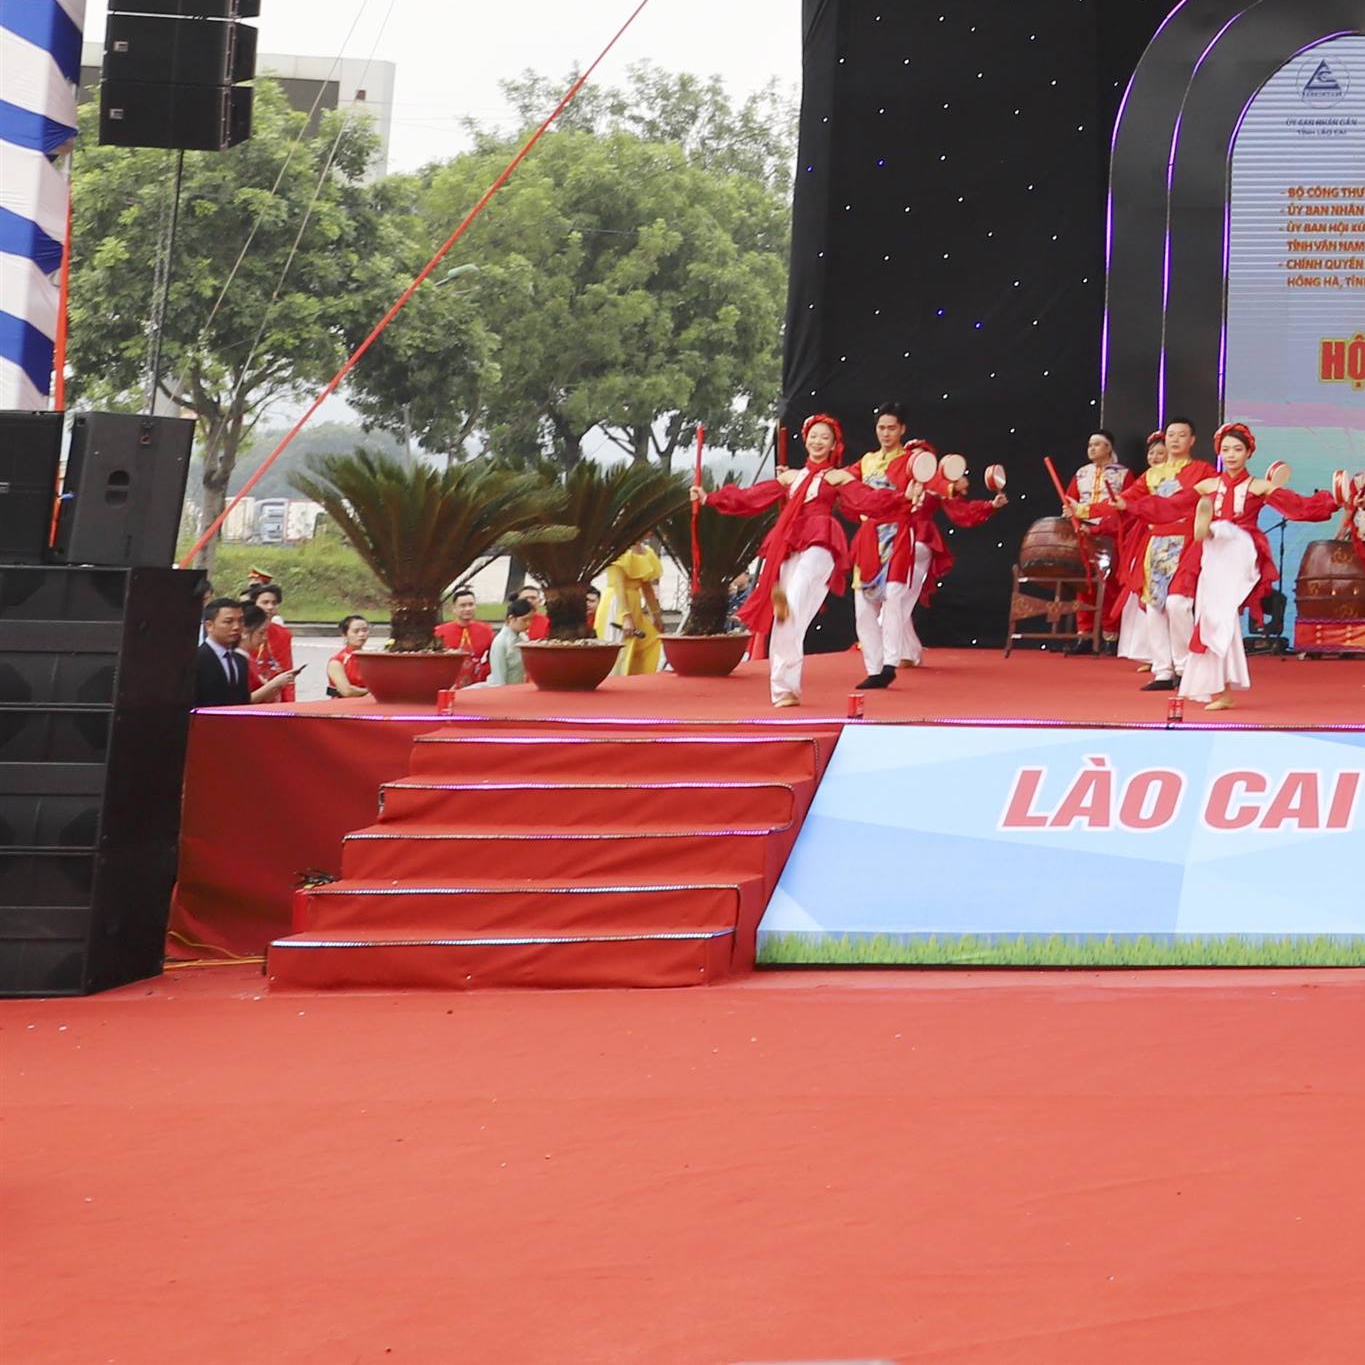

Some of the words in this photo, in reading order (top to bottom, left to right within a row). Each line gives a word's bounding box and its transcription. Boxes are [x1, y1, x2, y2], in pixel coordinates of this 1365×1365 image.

[1305, 205, 1328, 215] BAN
[1001, 757, 1185, 829] LÀO
[1203, 771, 1361, 829] CAI
